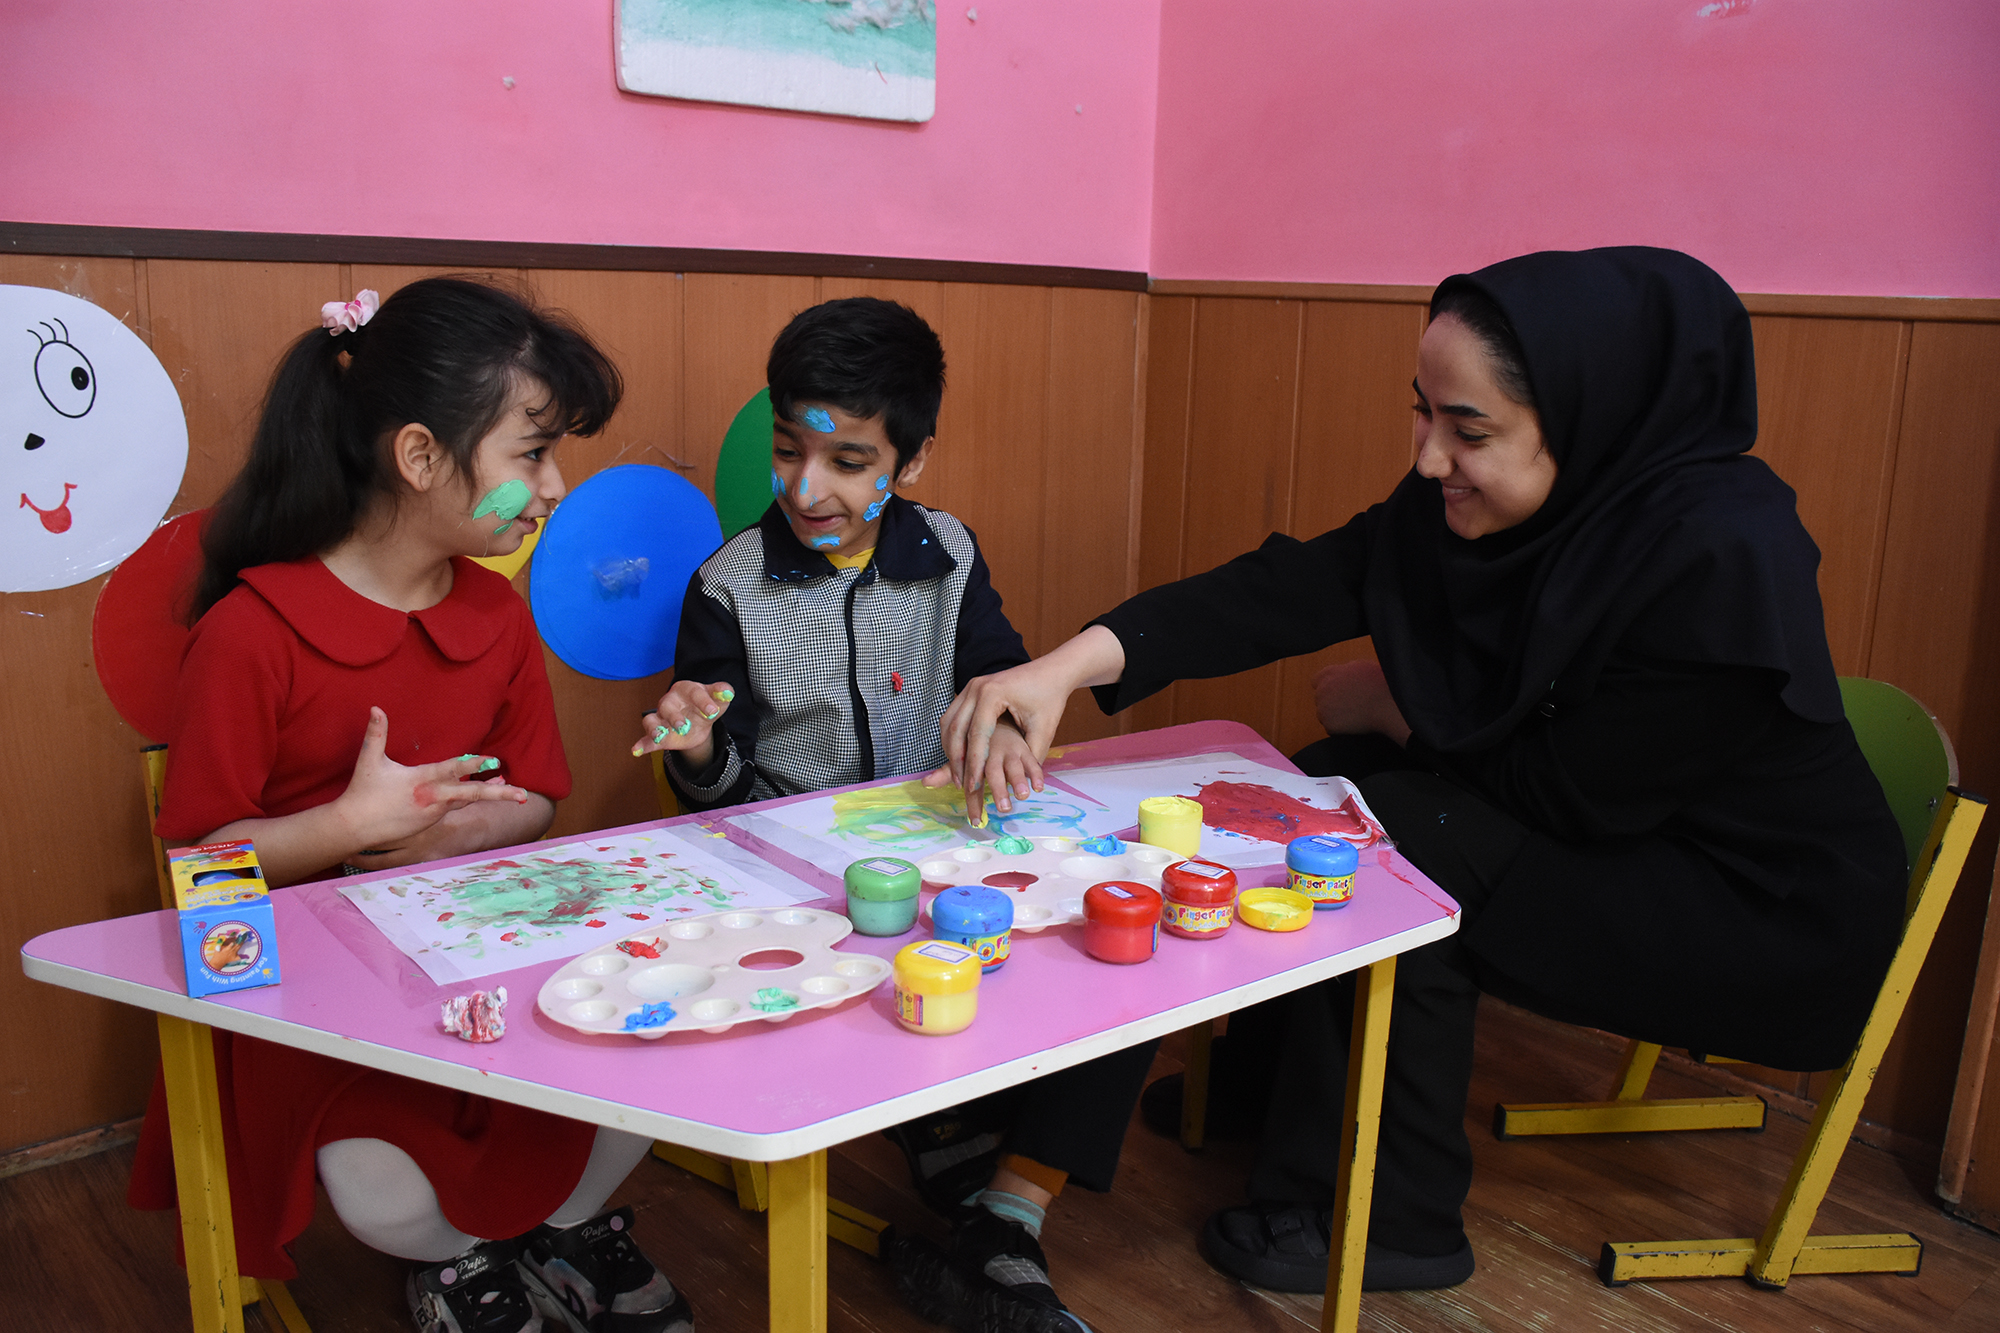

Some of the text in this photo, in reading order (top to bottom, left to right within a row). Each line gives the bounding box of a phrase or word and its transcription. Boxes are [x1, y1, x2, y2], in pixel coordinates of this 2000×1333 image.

[1294, 874, 1348, 891] Finger paint
[1178, 907, 1216, 921] Finger
[199, 956, 268, 985] For Painting With Fun
[455, 1255, 488, 1274] Pafix
